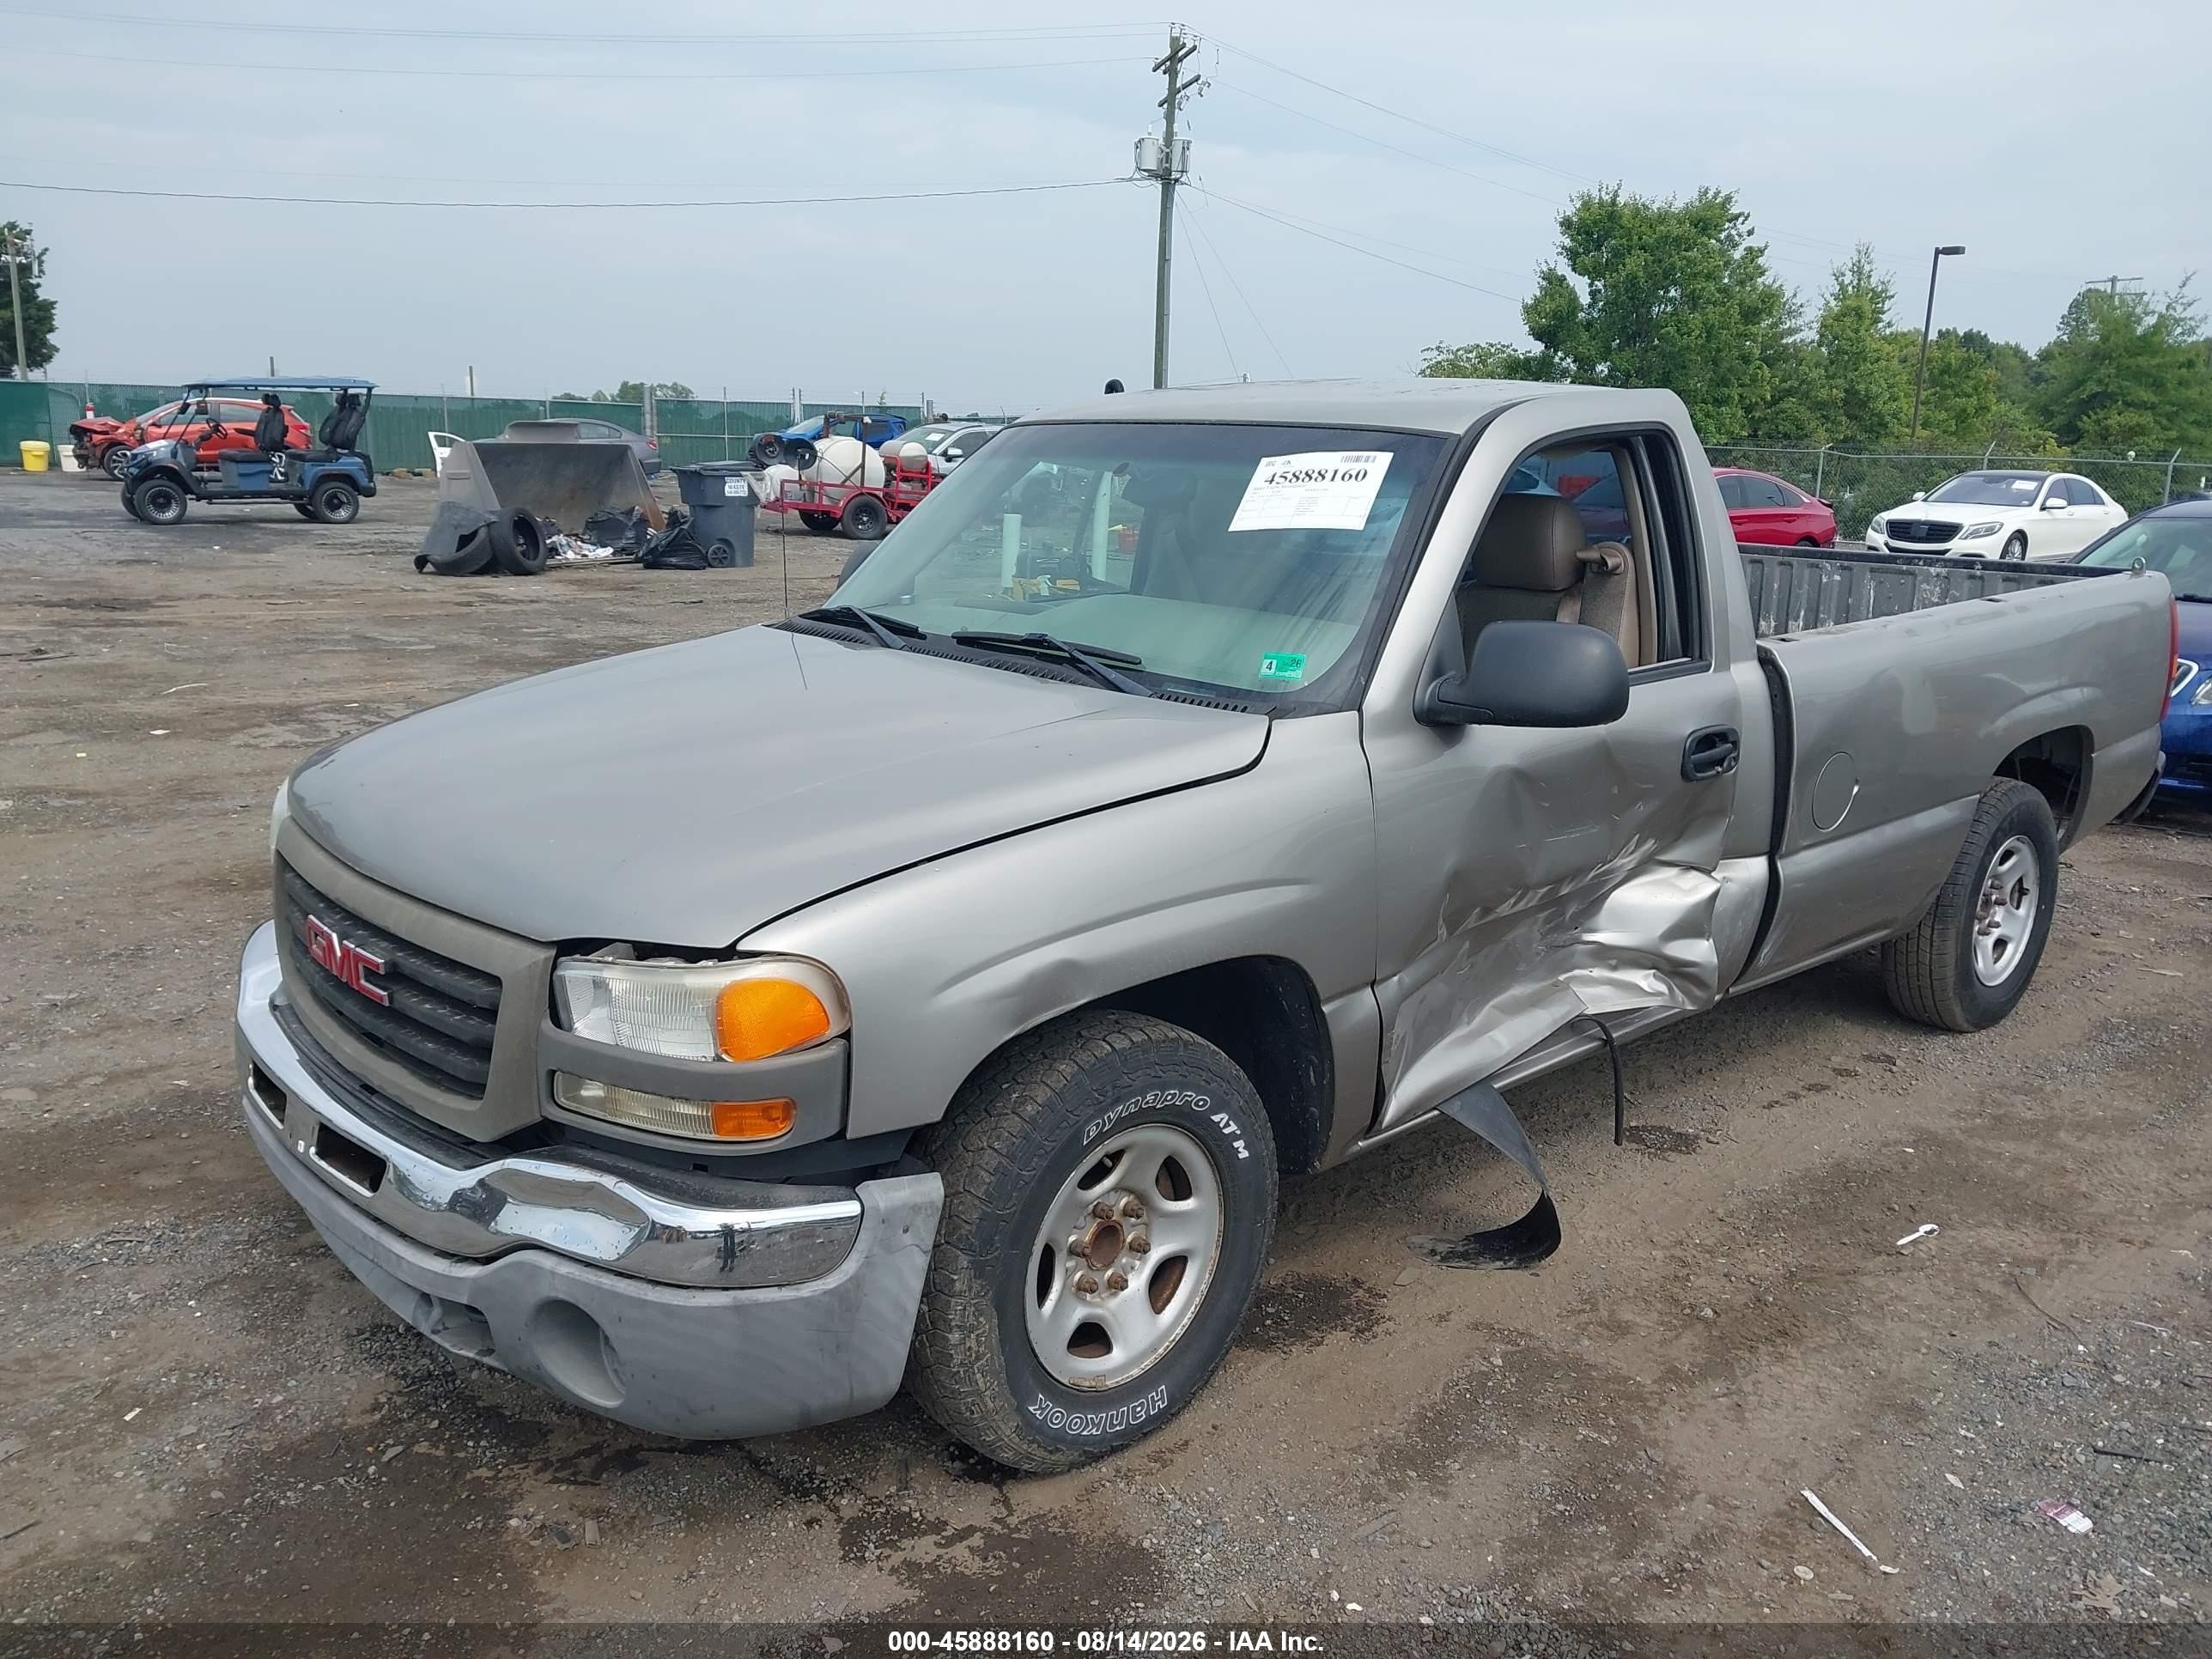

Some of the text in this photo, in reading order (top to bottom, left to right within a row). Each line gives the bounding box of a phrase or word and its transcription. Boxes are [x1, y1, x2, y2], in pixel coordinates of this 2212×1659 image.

[1263, 468, 1368, 485] 45888160
[1266, 660, 1273, 672] 4
[306, 914, 390, 1007] GMC
[1083, 1089, 1211, 1146] Dynapro
[1029, 1384, 1168, 1436] Hankook
